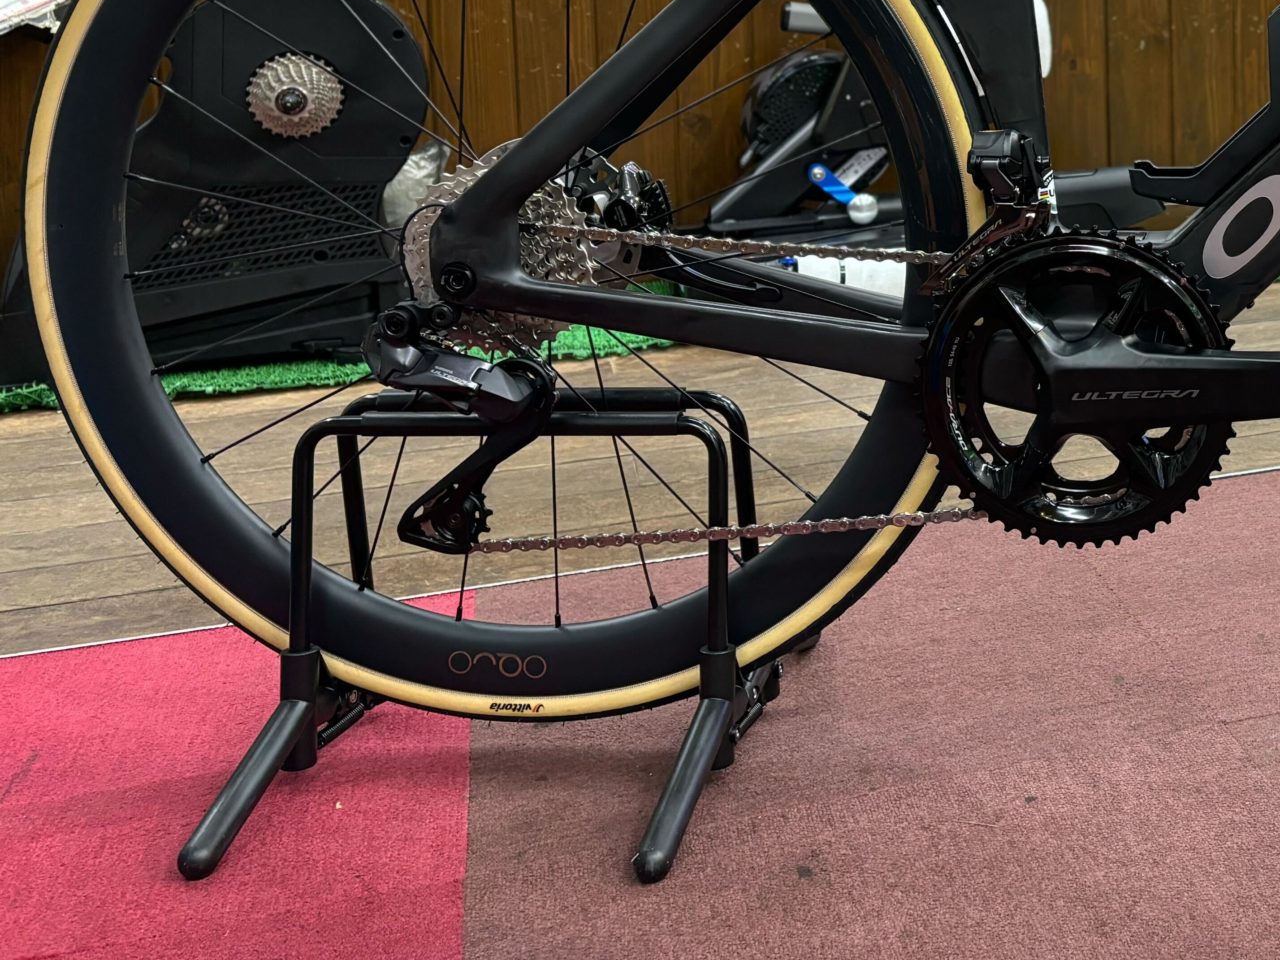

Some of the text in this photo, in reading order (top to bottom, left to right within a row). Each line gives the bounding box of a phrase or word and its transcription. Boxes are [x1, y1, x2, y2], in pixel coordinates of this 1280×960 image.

[953, 219, 1002, 261] ULTEGRA
[1071, 389, 1200, 401] ULTEGRA
[945, 376, 968, 450] DURA-ACE
[448, 650, 547, 679] OQUO
[489, 702, 532, 713] vittoria
